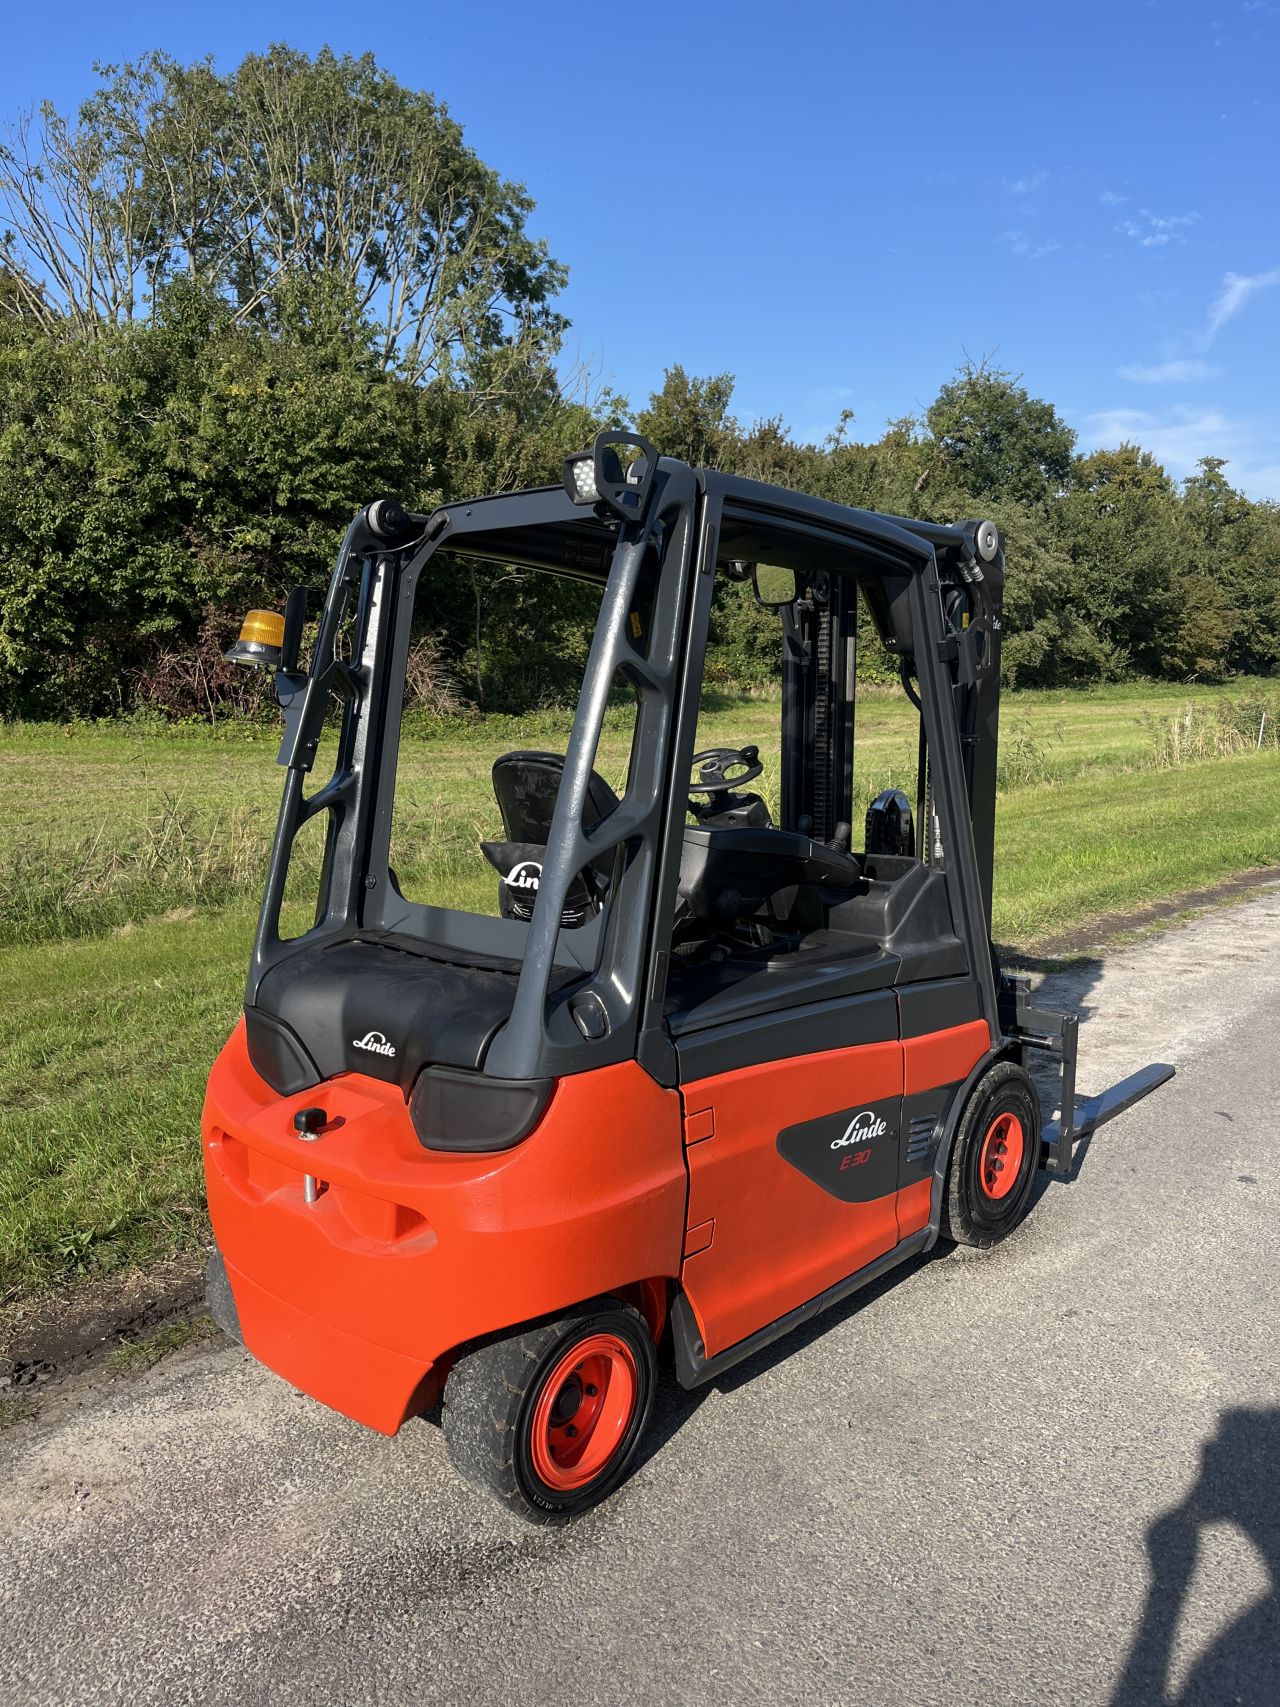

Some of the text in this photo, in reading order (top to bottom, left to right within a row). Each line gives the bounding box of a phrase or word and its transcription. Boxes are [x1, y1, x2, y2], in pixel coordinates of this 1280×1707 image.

[500, 861, 543, 890] Lin
[352, 1031, 396, 1057] Linde
[830, 1111, 887, 1150] Linde
